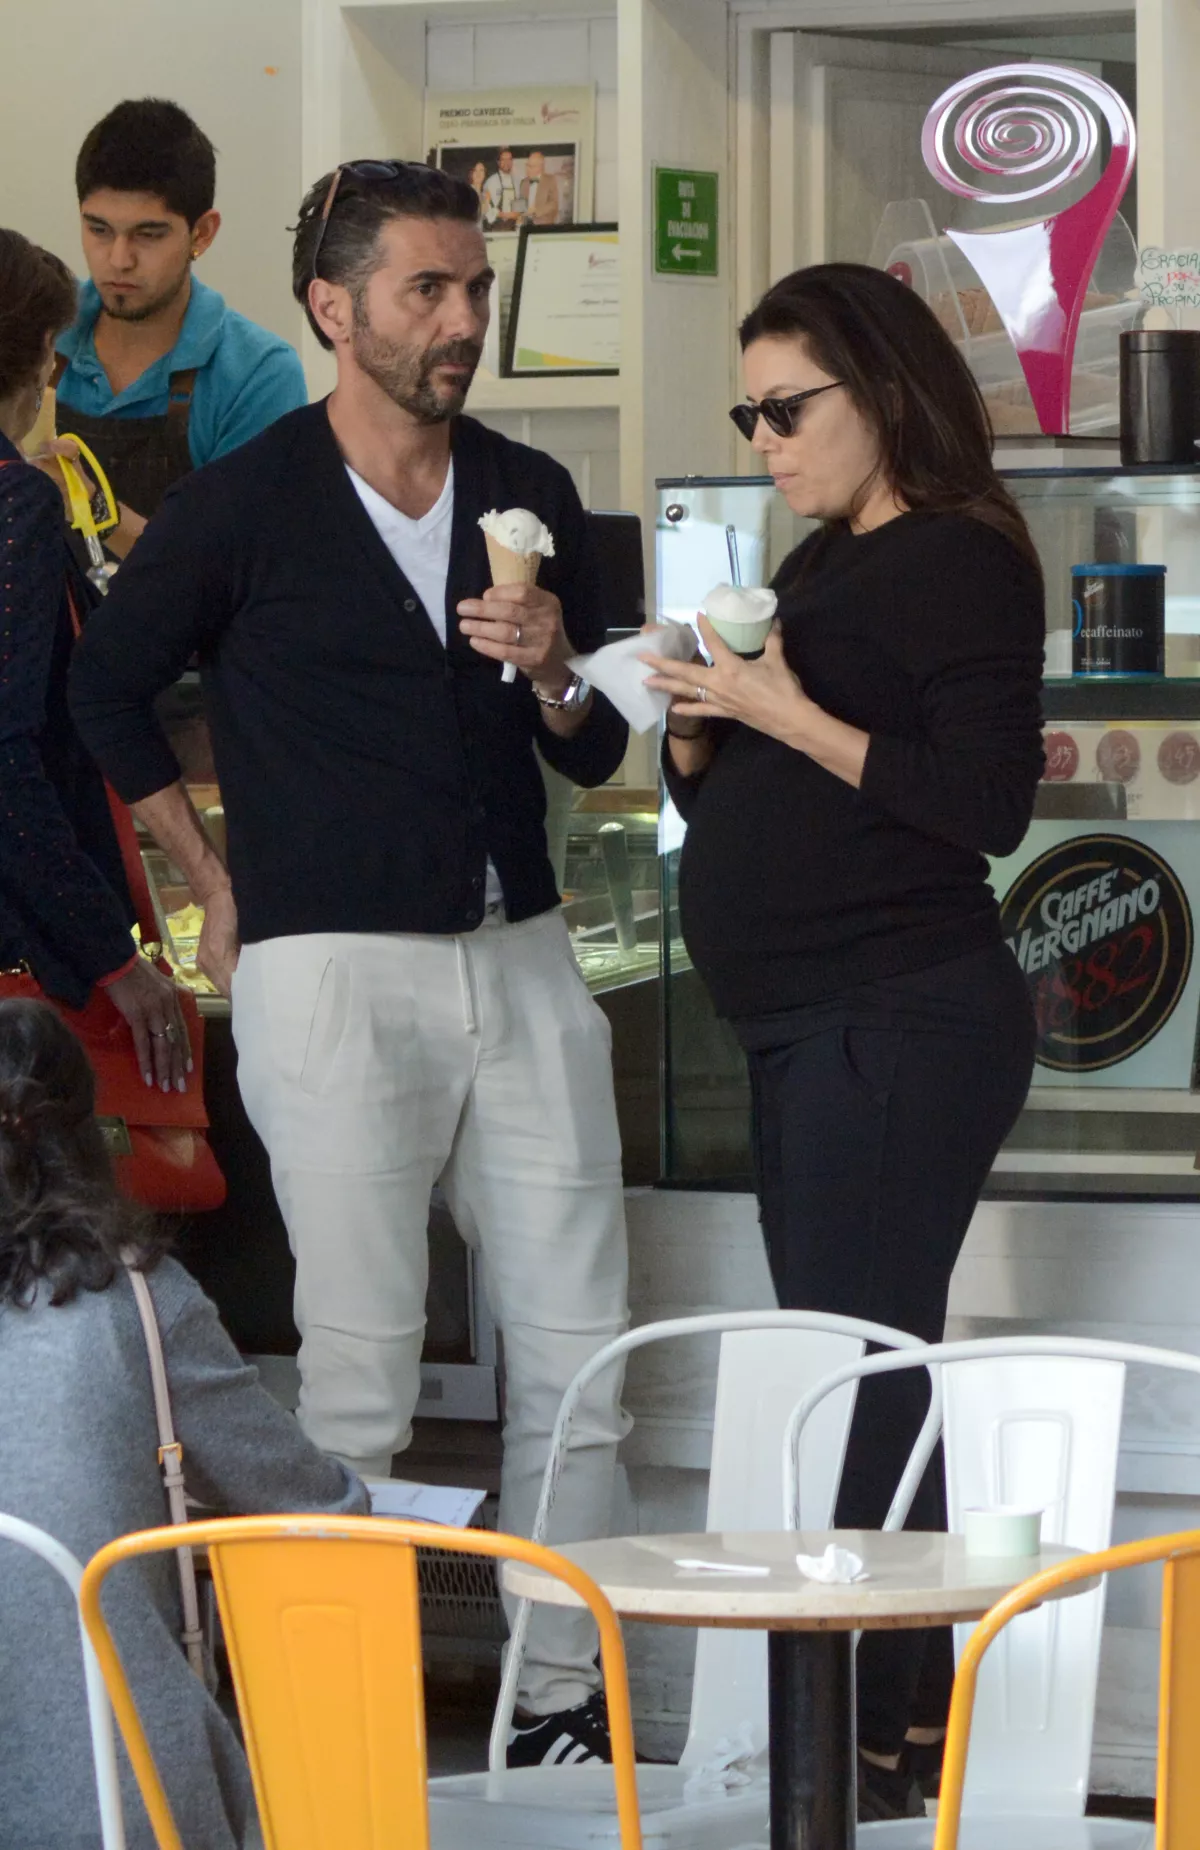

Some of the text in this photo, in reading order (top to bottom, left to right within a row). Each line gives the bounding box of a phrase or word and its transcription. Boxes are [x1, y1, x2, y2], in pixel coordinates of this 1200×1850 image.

[439, 108, 472, 118] PREMIO
[1140, 247, 1200, 275] GRACIA
[1004, 879, 1161, 976] VERGNANO
